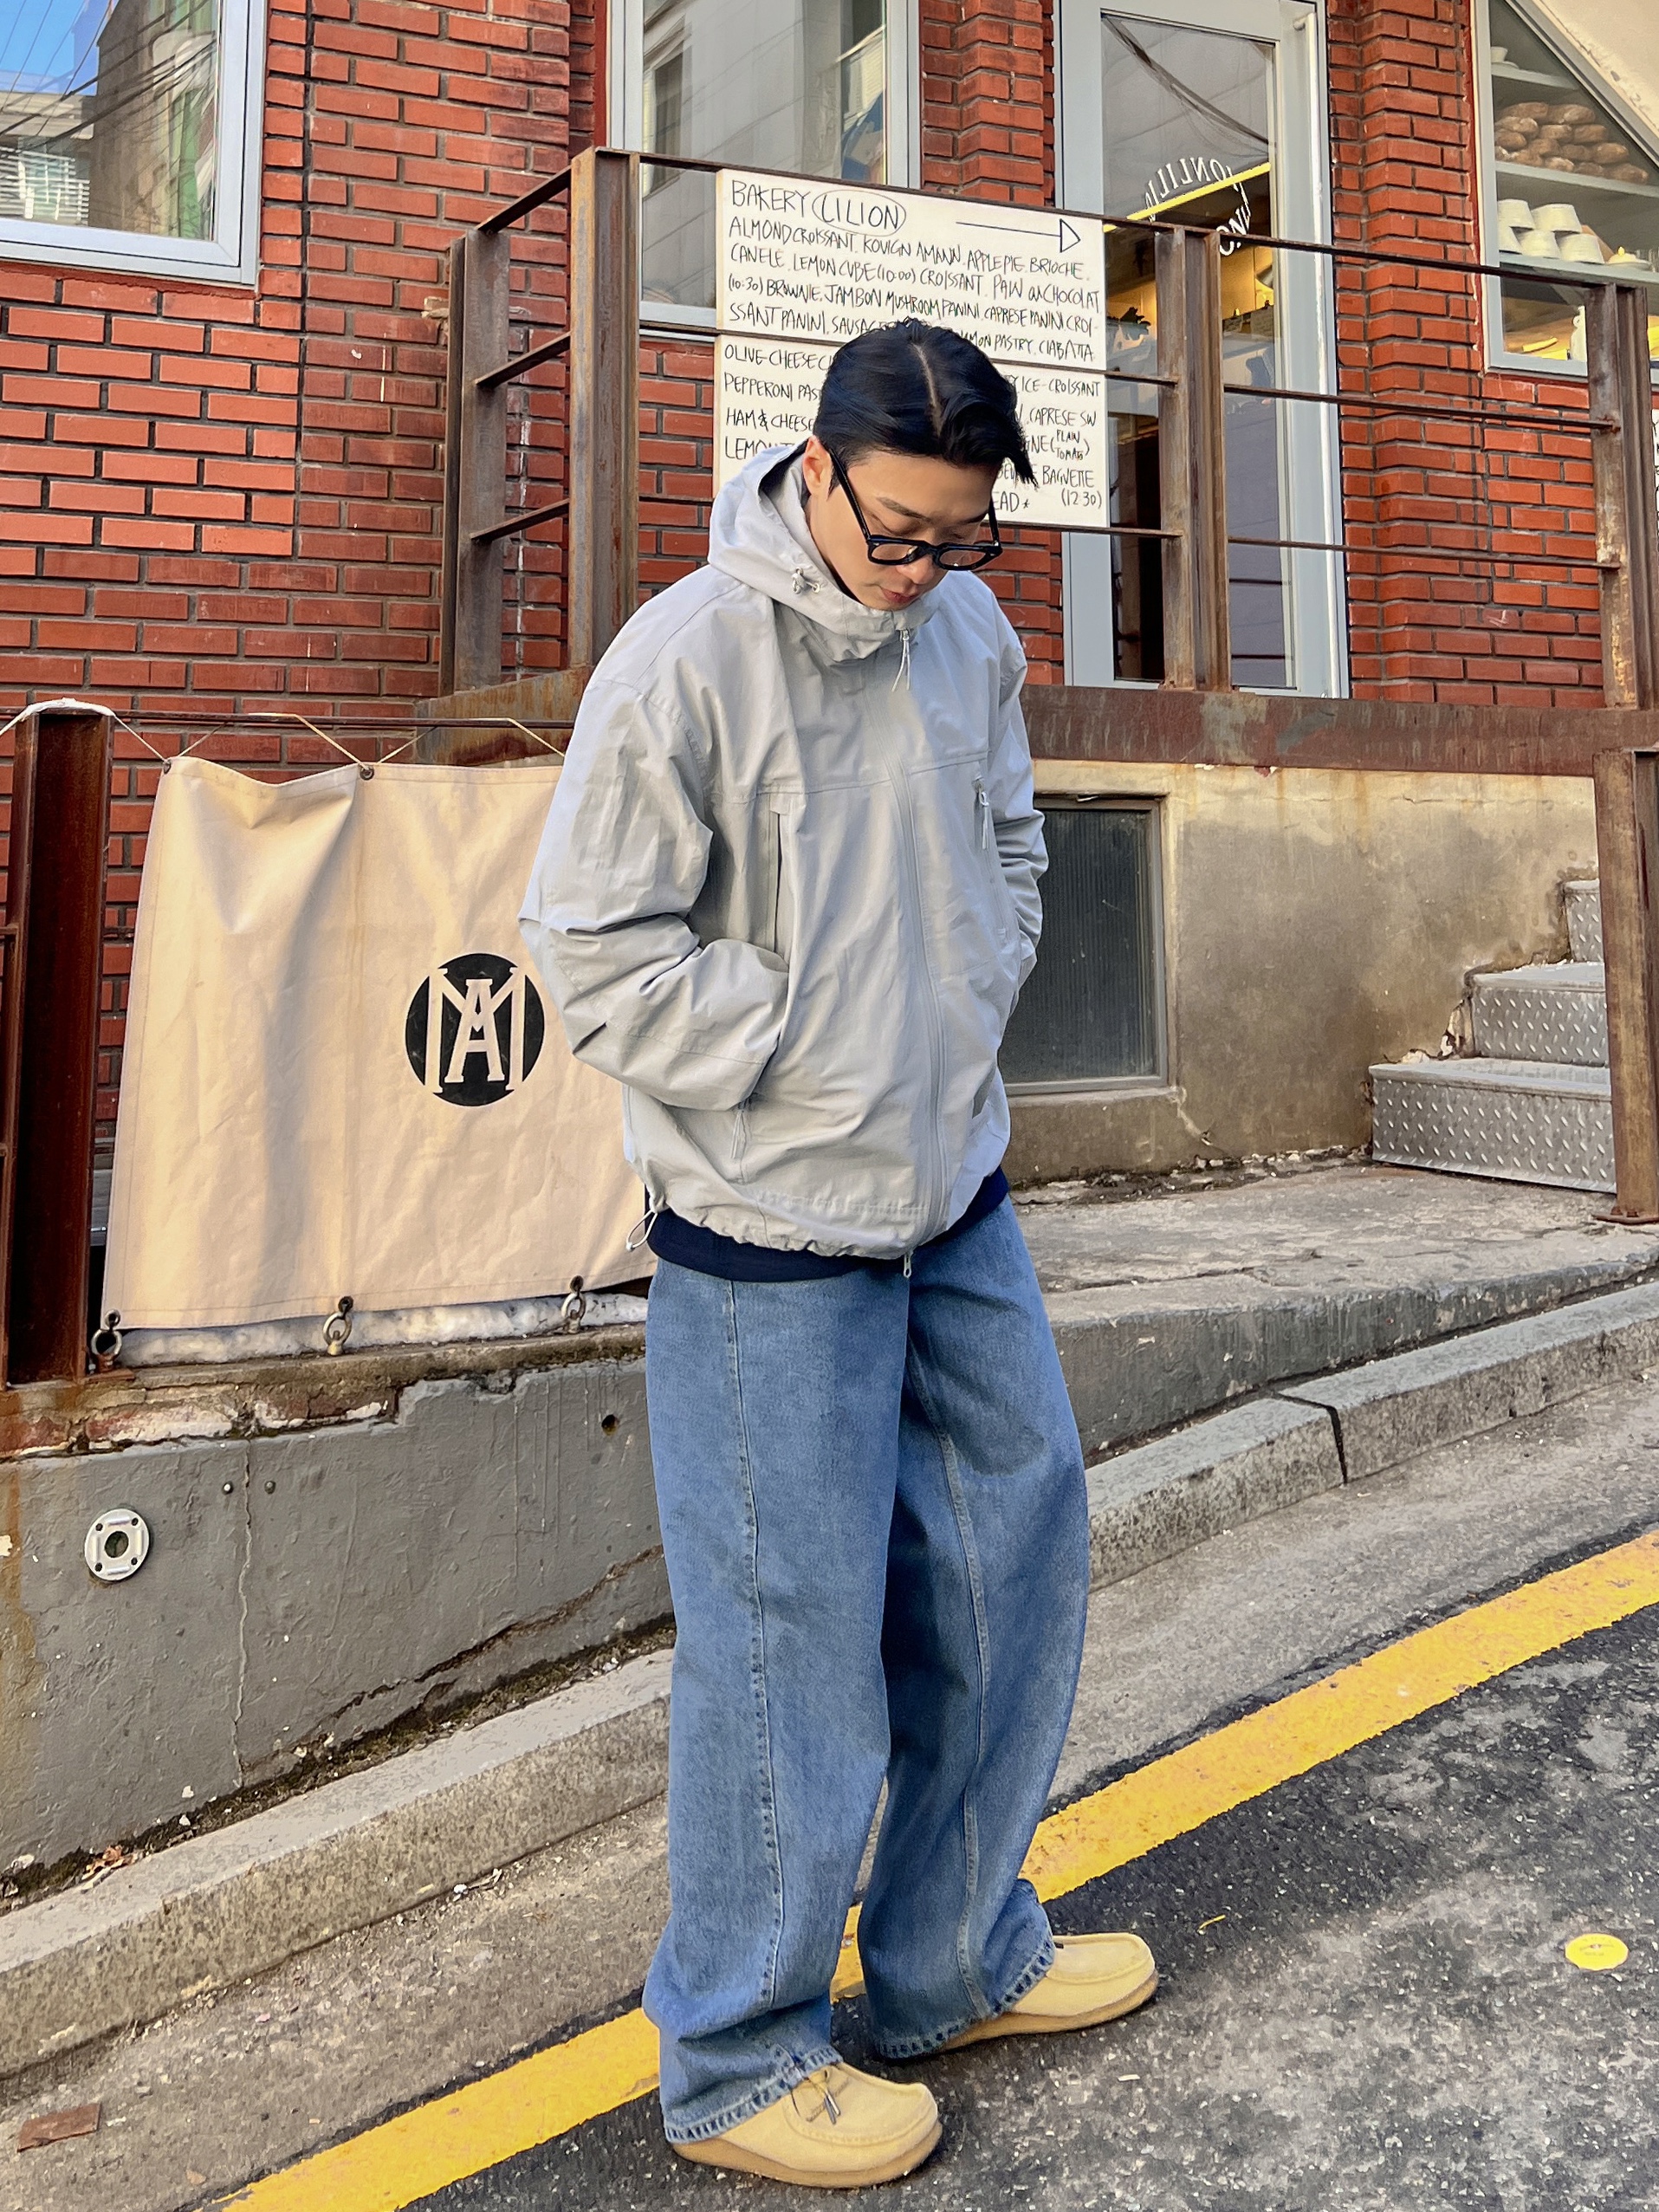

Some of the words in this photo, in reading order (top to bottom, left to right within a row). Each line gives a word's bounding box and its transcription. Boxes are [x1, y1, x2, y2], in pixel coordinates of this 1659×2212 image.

[731, 179, 811, 217] BAKERY
[821, 194, 899, 230] LILION
[794, 254, 836, 277] LEMON
[824, 283, 882, 308] JAMBON
[724, 371, 793, 402] PEPPERONI
[726, 406, 757, 430] HAM
